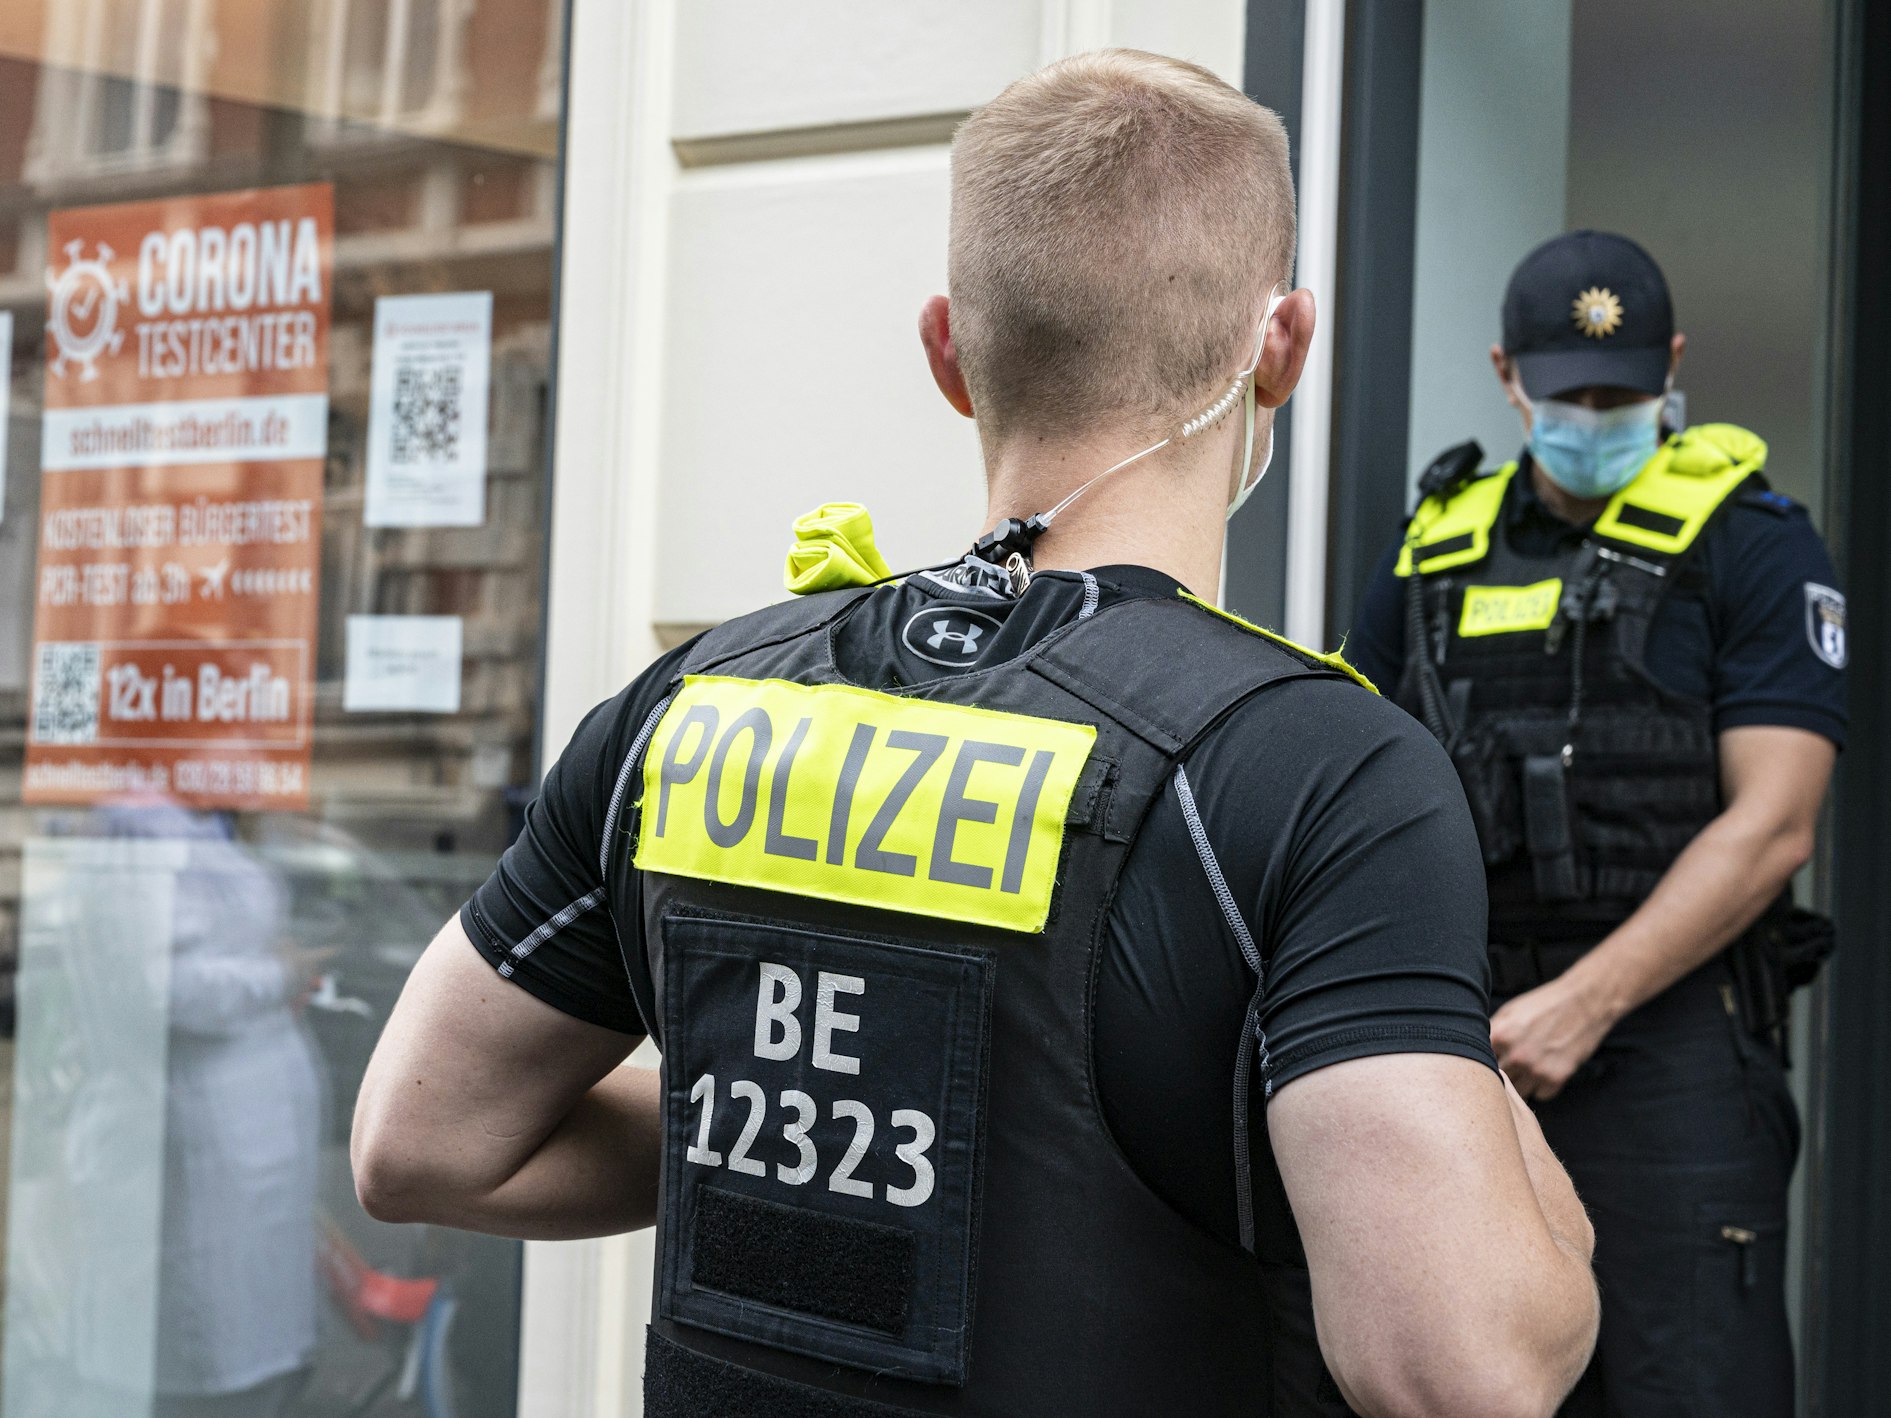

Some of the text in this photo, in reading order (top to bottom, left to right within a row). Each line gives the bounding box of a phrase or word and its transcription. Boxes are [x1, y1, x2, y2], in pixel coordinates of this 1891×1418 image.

[137, 216, 321, 317] CORONA
[135, 311, 317, 379] TESTCENTER
[70, 409, 289, 456] schnelltestberlin.de
[107, 661, 291, 722] 12x in Berlin
[655, 704, 1056, 895] POLIZEI
[753, 961, 866, 1076] BE
[686, 1072, 936, 1208] 12323
